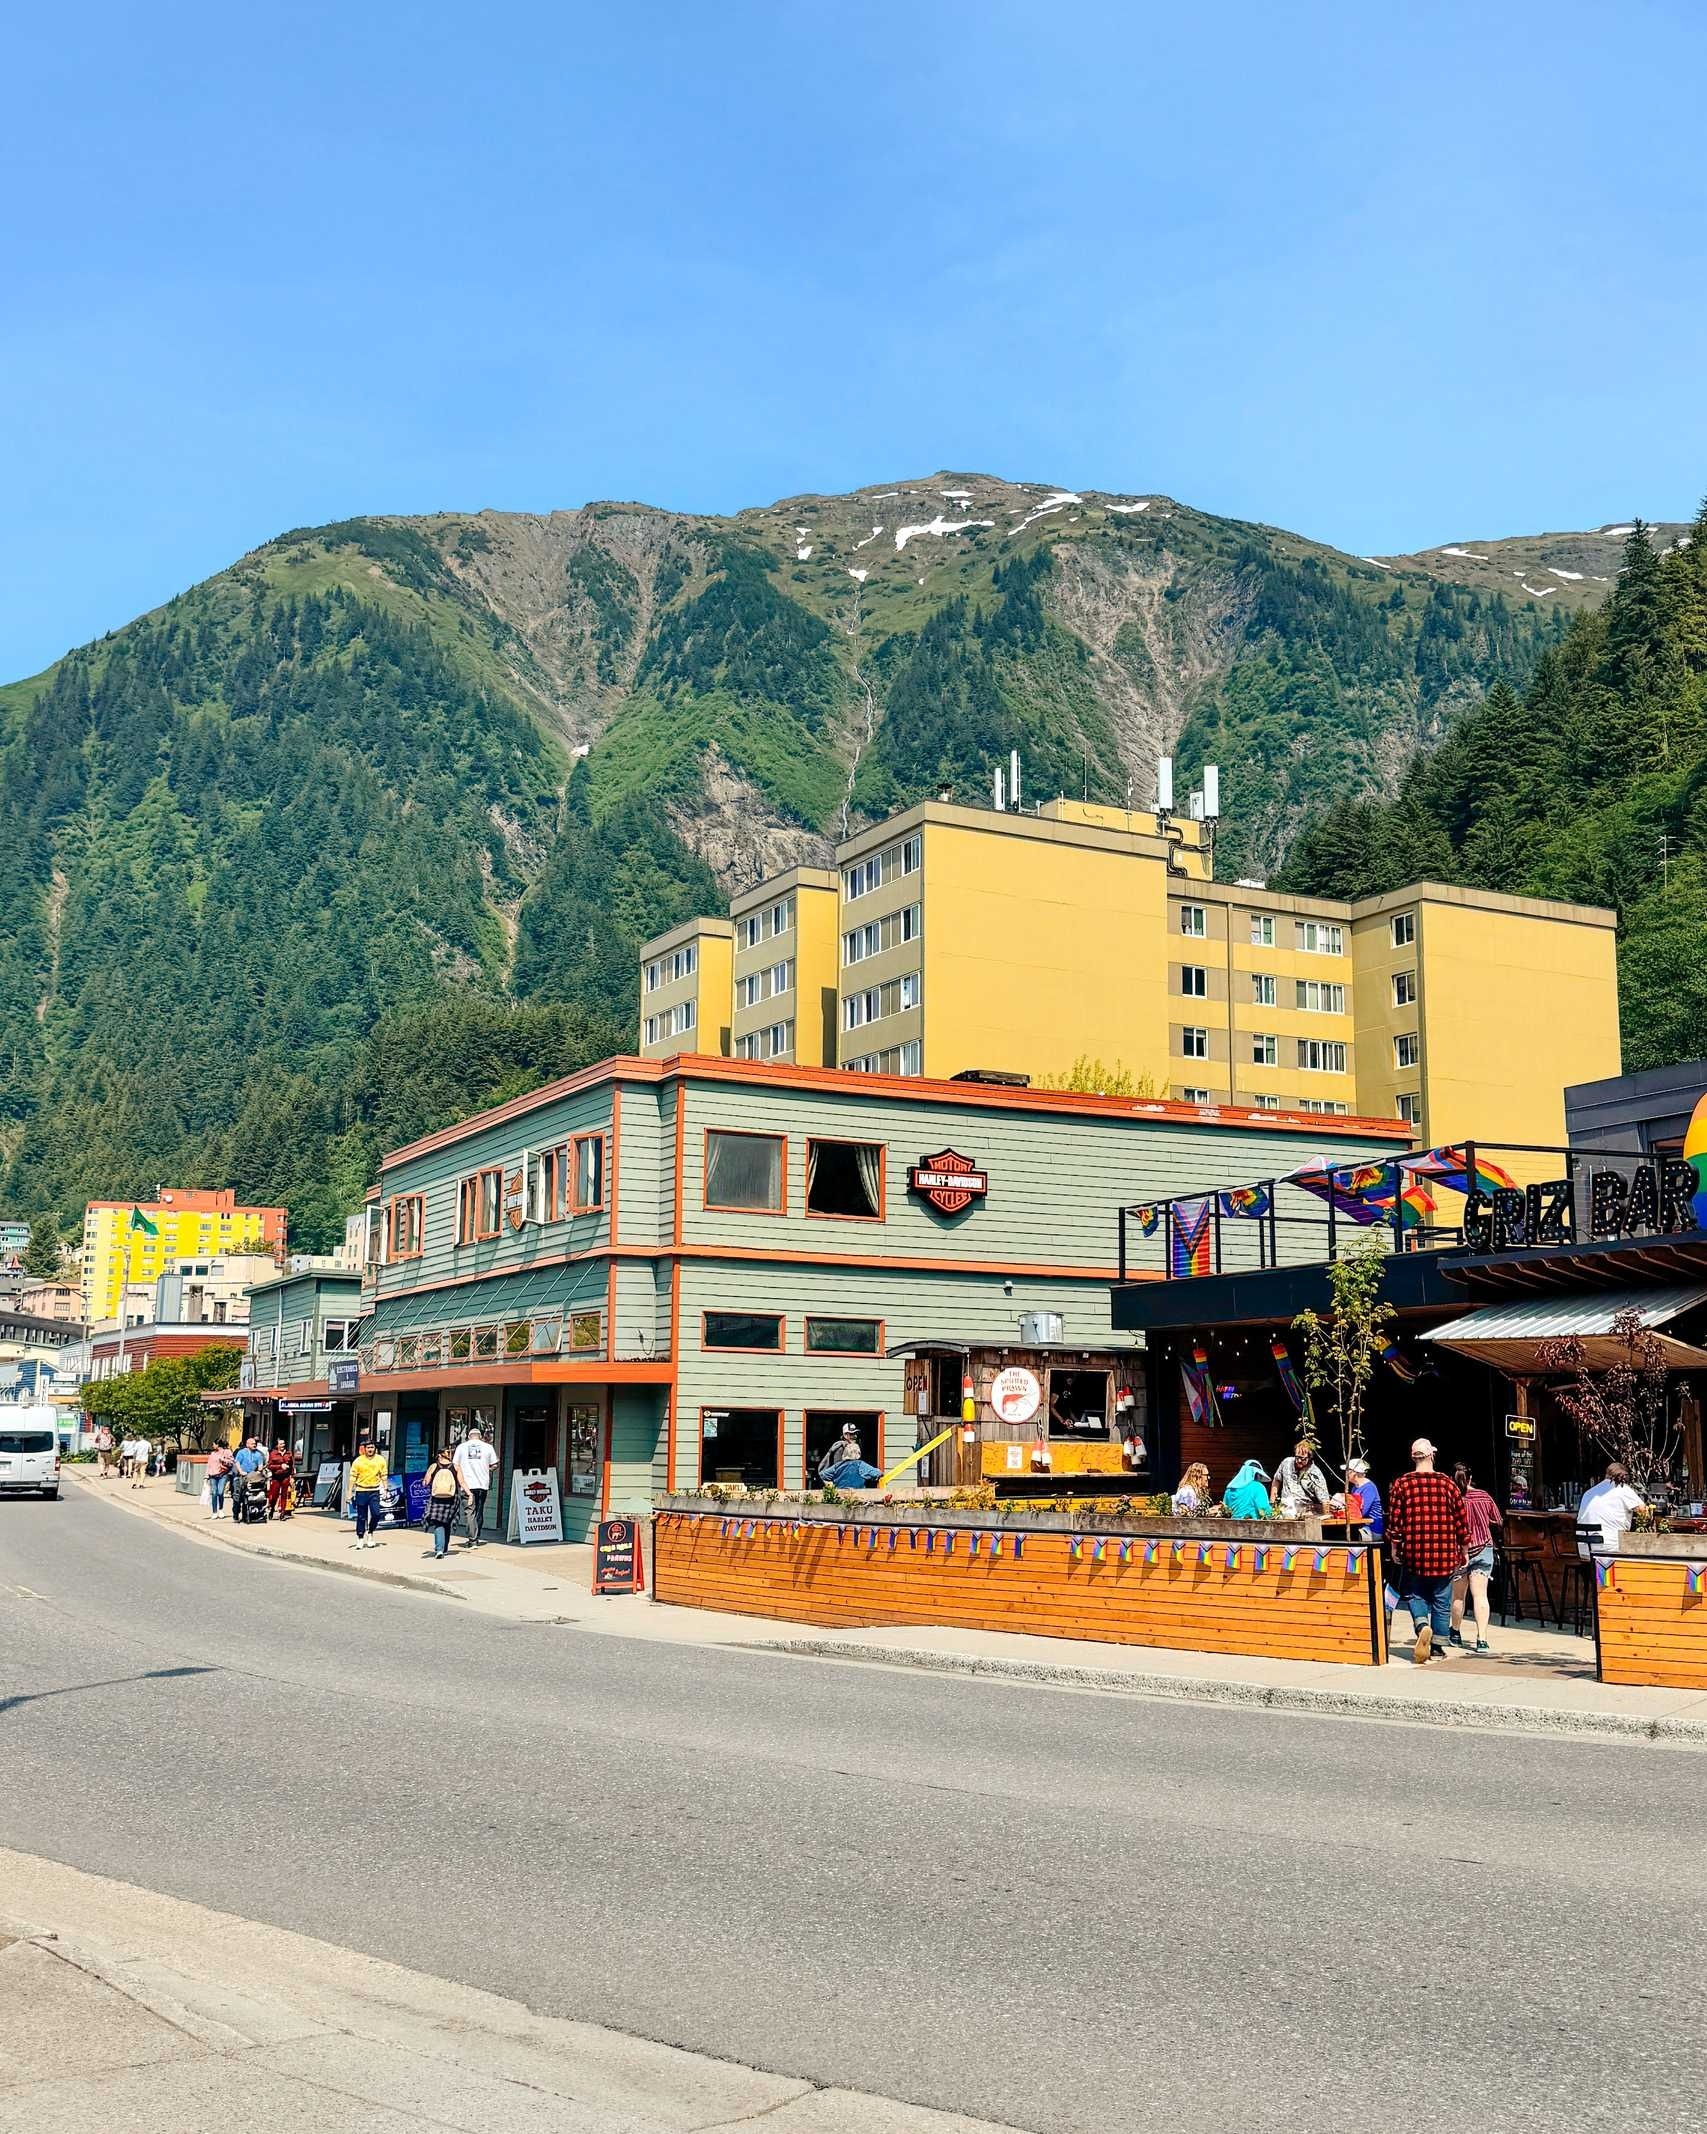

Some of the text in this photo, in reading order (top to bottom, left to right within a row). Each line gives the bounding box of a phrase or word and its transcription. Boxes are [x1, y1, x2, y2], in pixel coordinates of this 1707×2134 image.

[933, 1157, 968, 1172] MOTOR
[918, 1173, 983, 1189] HARLEY-DAVIDSON
[933, 1190, 968, 1208] CYCLES
[1464, 1160, 1699, 1249] GRIZ BAR
[906, 1376, 928, 1392] OPEN
[1509, 1421, 1533, 1434] OPEN
[724, 1484, 743, 1492] TAKU
[525, 1506, 553, 1516] TAKU
[525, 1524, 557, 1532] DAVIDSON
